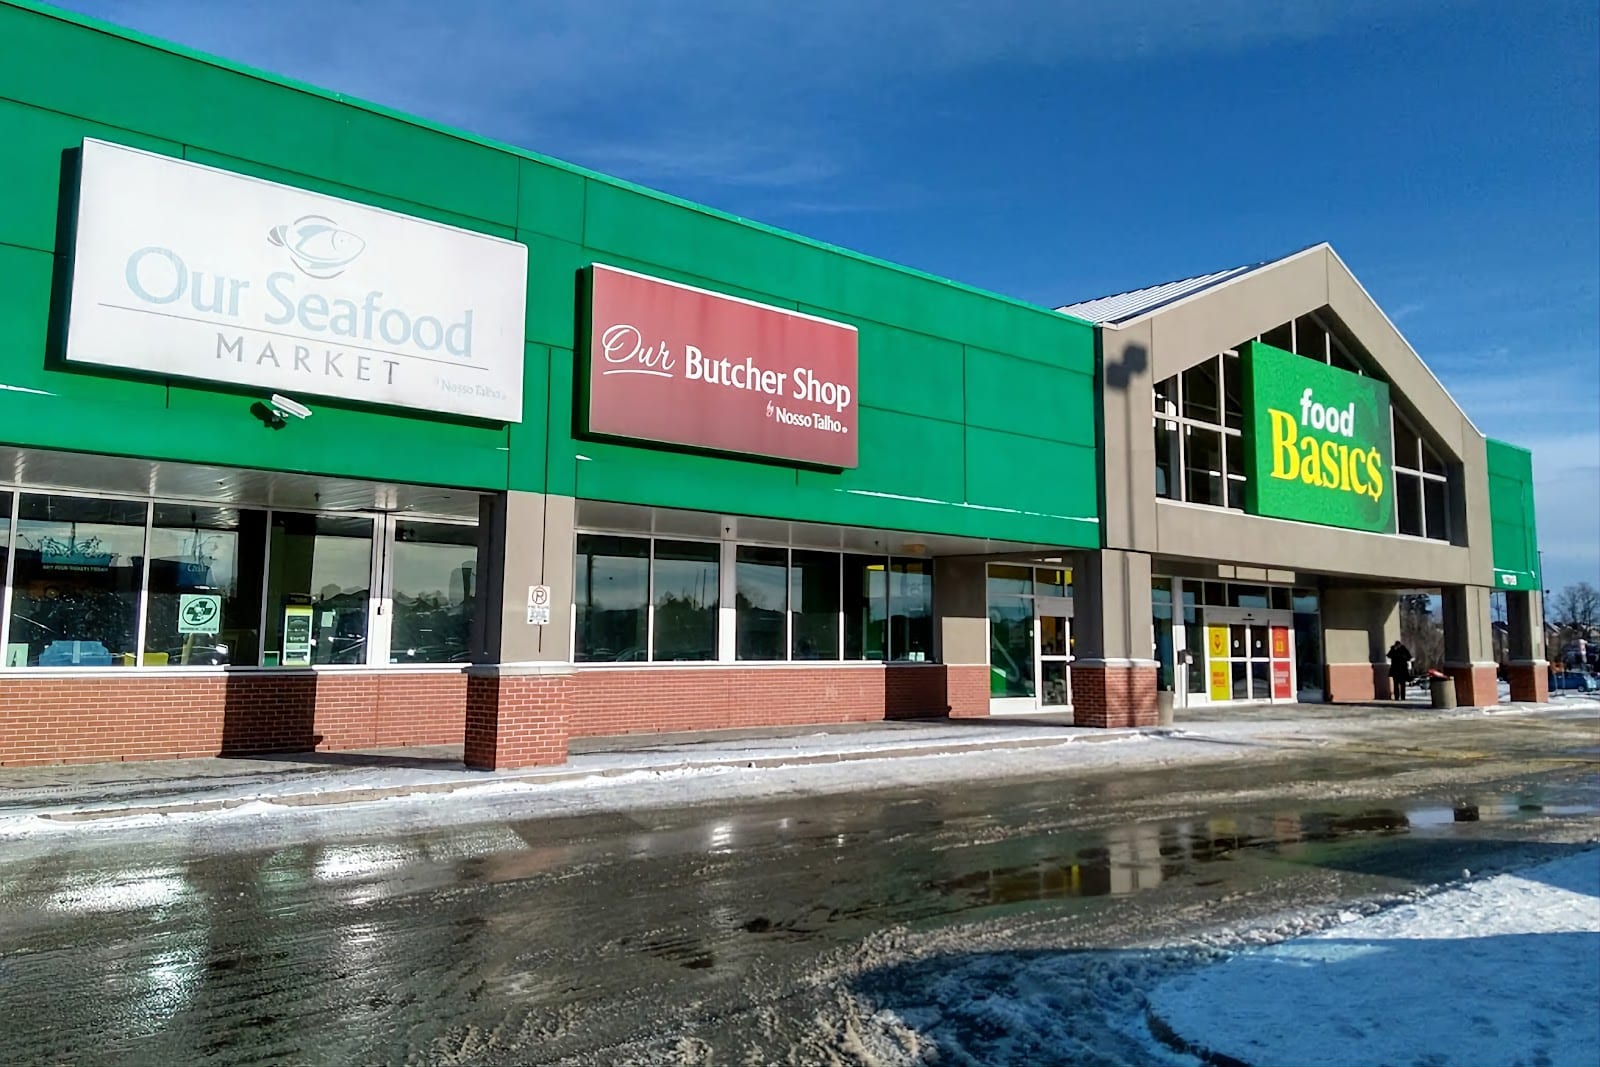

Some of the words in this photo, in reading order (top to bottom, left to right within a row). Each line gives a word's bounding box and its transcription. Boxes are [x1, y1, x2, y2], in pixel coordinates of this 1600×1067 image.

[125, 246, 249, 316] Our
[264, 271, 473, 357] Seafood
[216, 332, 400, 385] MARKET
[602, 324, 676, 371] Our
[685, 345, 787, 396] Butcher
[793, 367, 851, 412] Shop
[776, 406, 812, 427] Nosso
[1300, 388, 1354, 437] food
